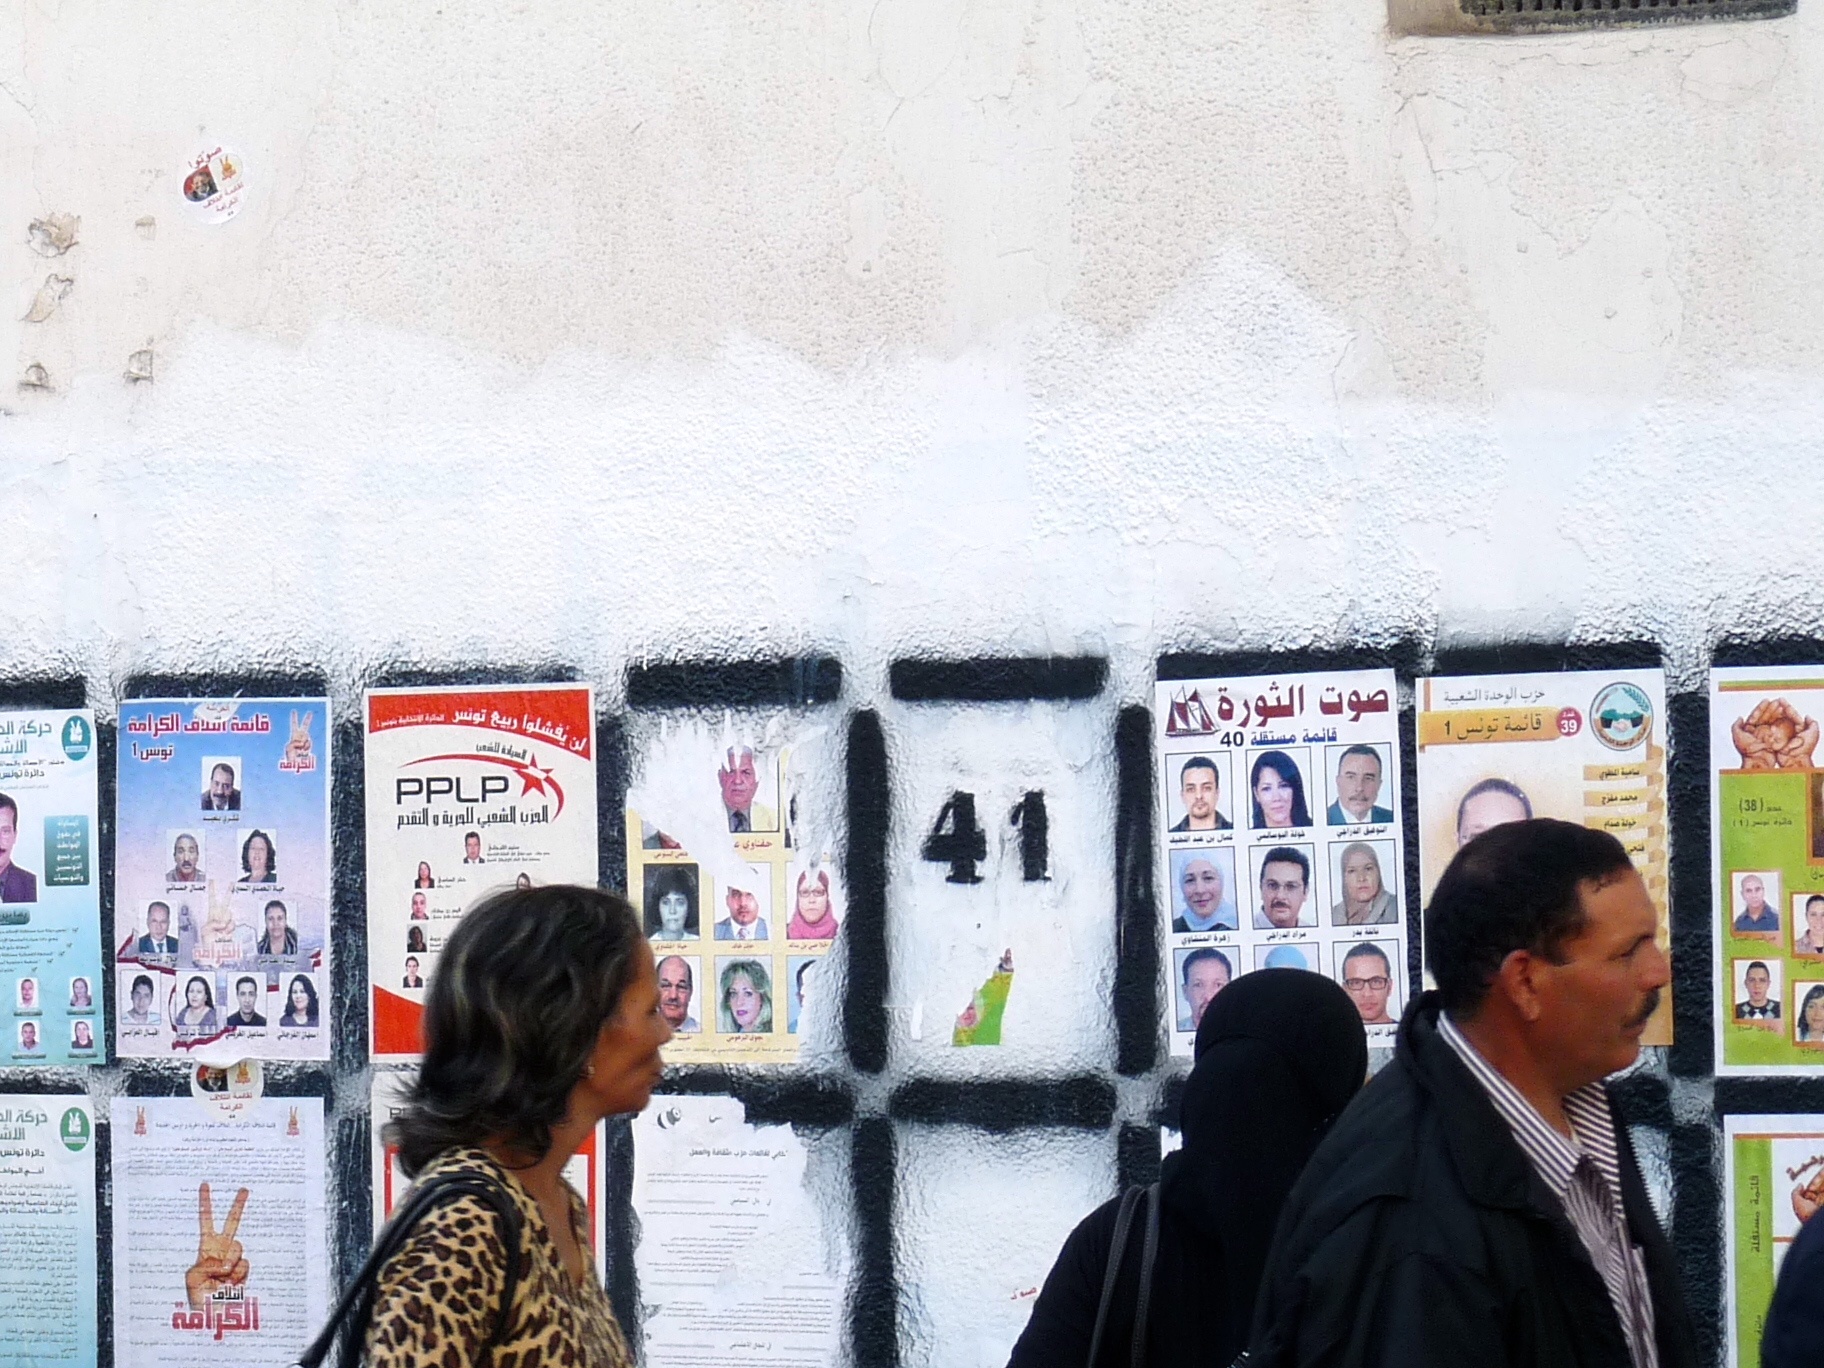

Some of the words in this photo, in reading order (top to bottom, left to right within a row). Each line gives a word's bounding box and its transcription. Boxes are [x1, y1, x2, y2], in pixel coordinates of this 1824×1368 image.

[1218, 681, 1304, 728] الثورة
[1319, 687, 1389, 722] صوت
[1444, 690, 1481, 703] الشعبية
[1485, 687, 1517, 704] الوحدة
[1520, 690, 1545, 703] حزب
[231, 714, 269, 732] قائمة
[452, 709, 486, 723] تونس
[490, 712, 517, 729] ربيع
[1505, 713, 1542, 731] قائمة
[19, 719, 52, 738] حركة
[128, 714, 179, 737] الكرامة
[1457, 719, 1498, 740] تونس
[1560, 719, 1577, 733] 39
[1220, 731, 1244, 747] 40
[1251, 730, 1296, 746] مستقلة
[1303, 727, 1337, 743] قائمة
[141, 744, 173, 760] تونس
[279, 756, 315, 772] الكرامة
[396, 776, 509, 804] PPLP
[397, 808, 428, 830] التقدم
[443, 807, 474, 828] للحرية
[477, 805, 516, 828] الشعبي
[520, 805, 549, 824] الحزب
[920, 788, 1052, 883] 41
[16, 1109, 48, 1127] حركة
[0, 1148, 24, 1158] تونس
[212, 1286, 244, 1300] ائتلاف
[172, 1296, 259, 1340] الكرامة
